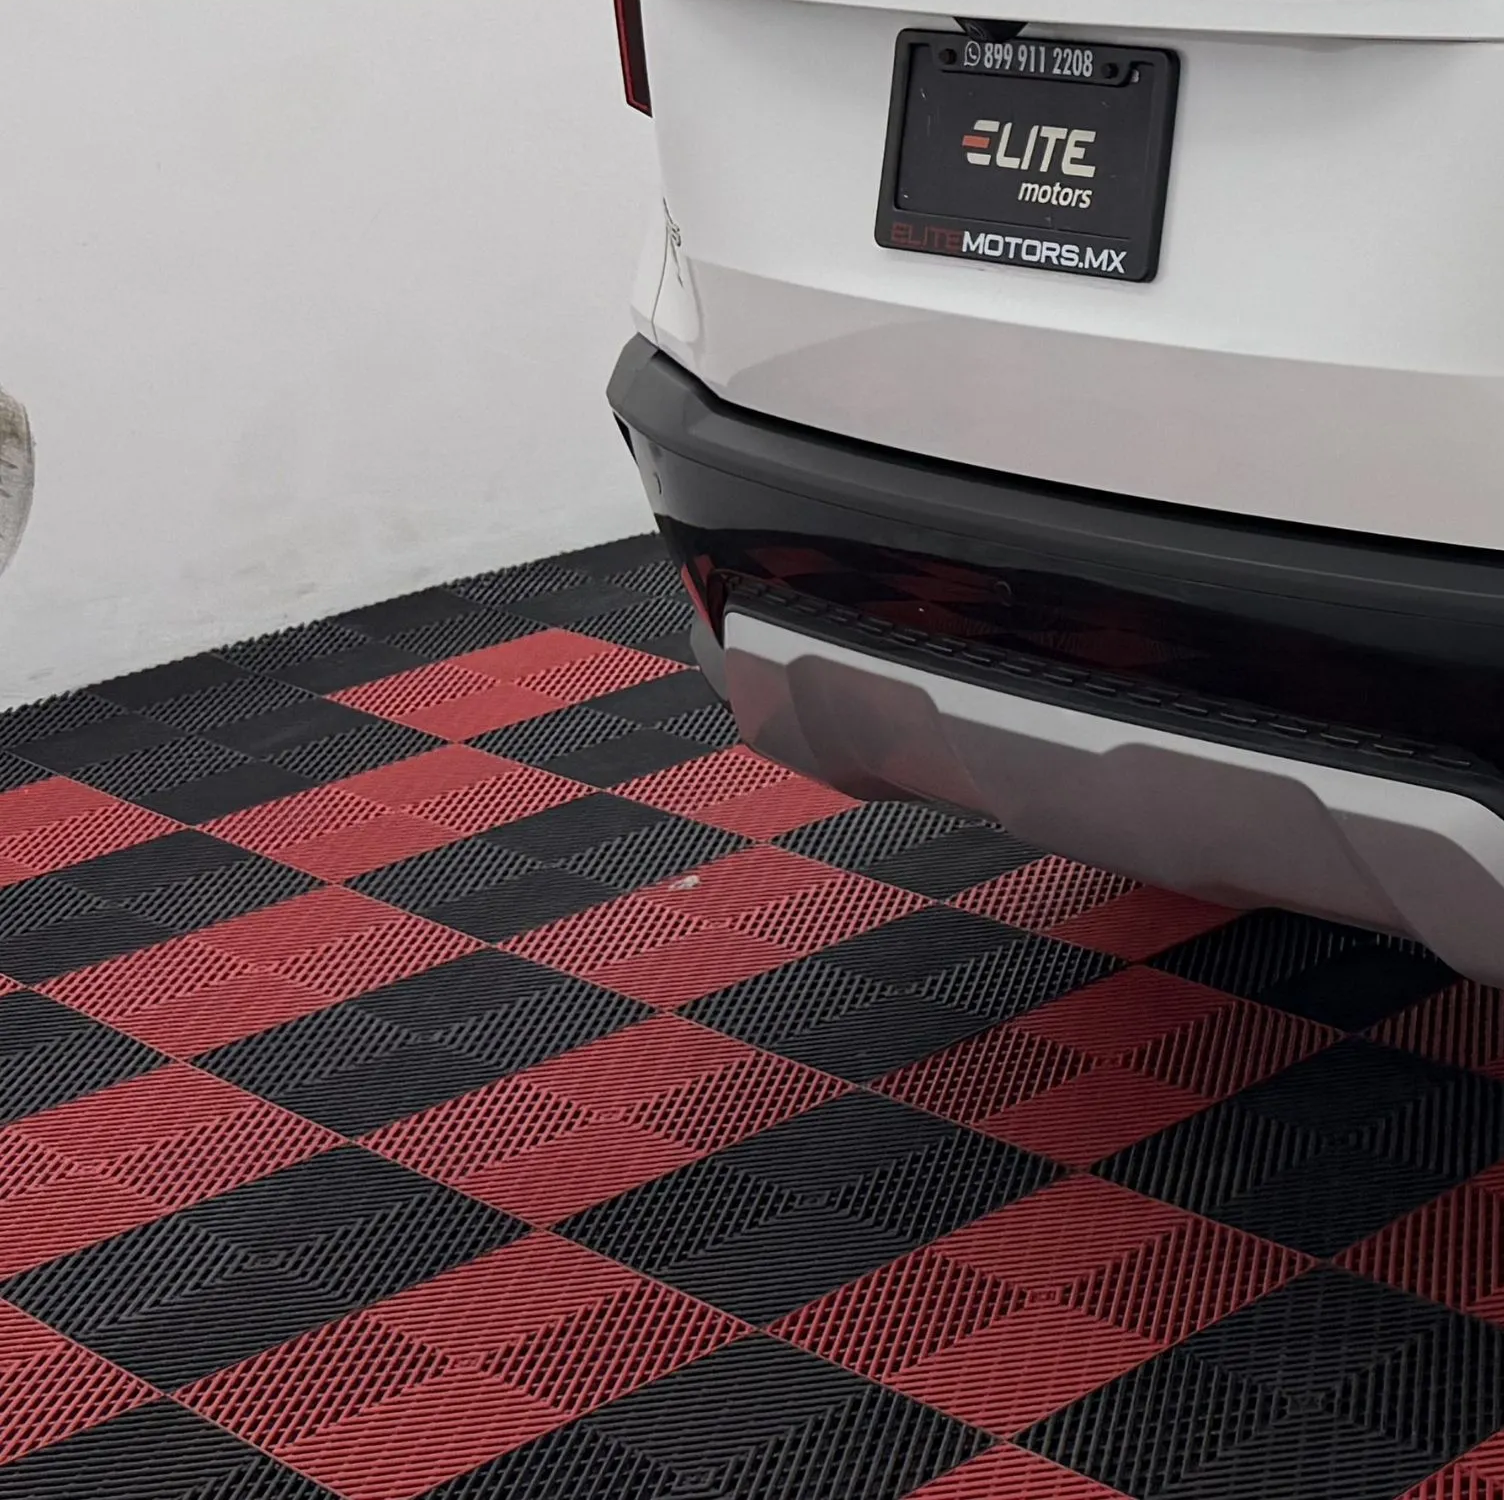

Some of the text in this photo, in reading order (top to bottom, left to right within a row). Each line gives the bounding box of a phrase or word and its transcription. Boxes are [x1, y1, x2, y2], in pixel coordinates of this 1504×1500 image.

[983, 43, 1094, 77] 899 911 2208
[962, 119, 1098, 178] ELITE
[1018, 180, 1093, 209] motors
